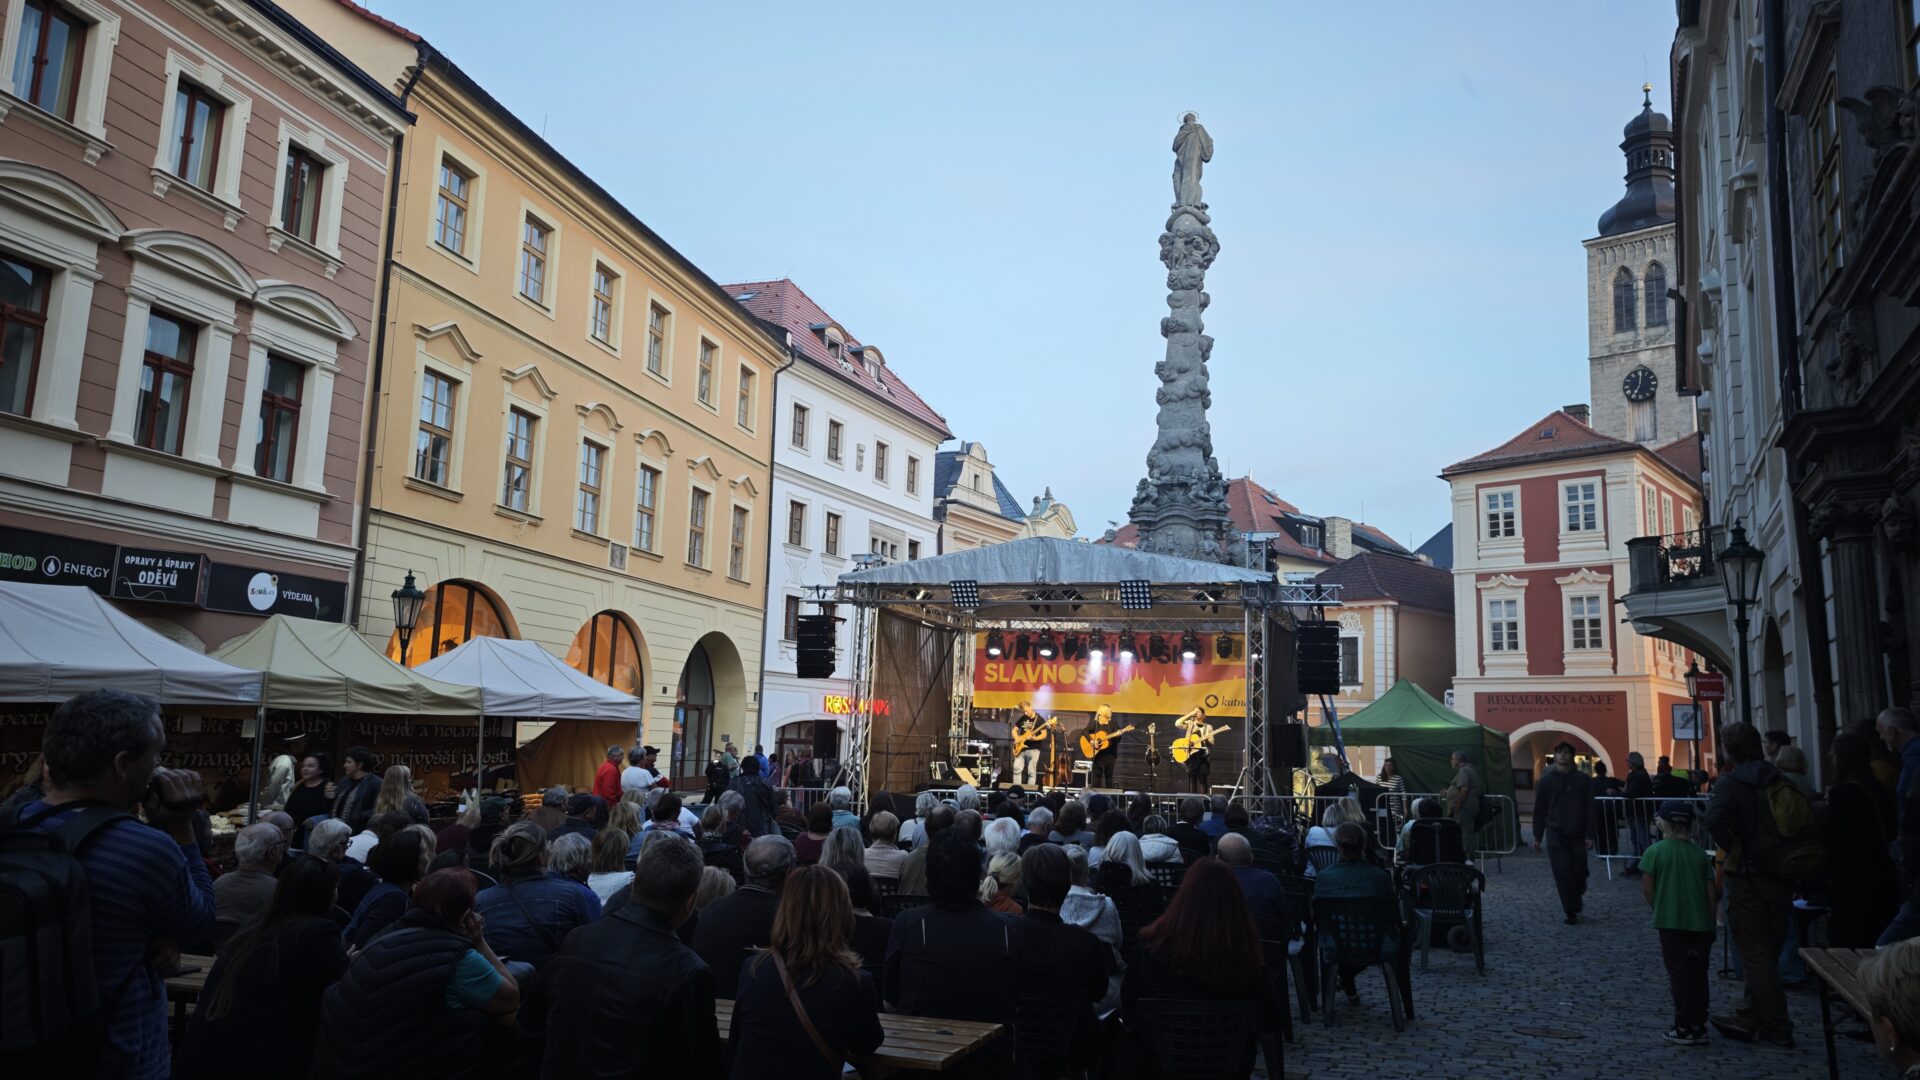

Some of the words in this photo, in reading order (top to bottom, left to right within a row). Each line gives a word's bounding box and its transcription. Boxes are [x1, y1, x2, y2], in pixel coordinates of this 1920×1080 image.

[63, 562, 110, 578] ENERGY
[124, 555, 156, 568] OPRAVY
[158, 558, 164, 567] A
[165, 557, 195, 570] ÚPRAVY
[138, 568, 178, 587] ODĚVŮ
[282, 590, 313, 603] VÝDEJNA
[1487, 694, 1570, 705] RESTAURANT
[419, 725, 429, 736] a
[461, 748, 511, 774] jaosti
